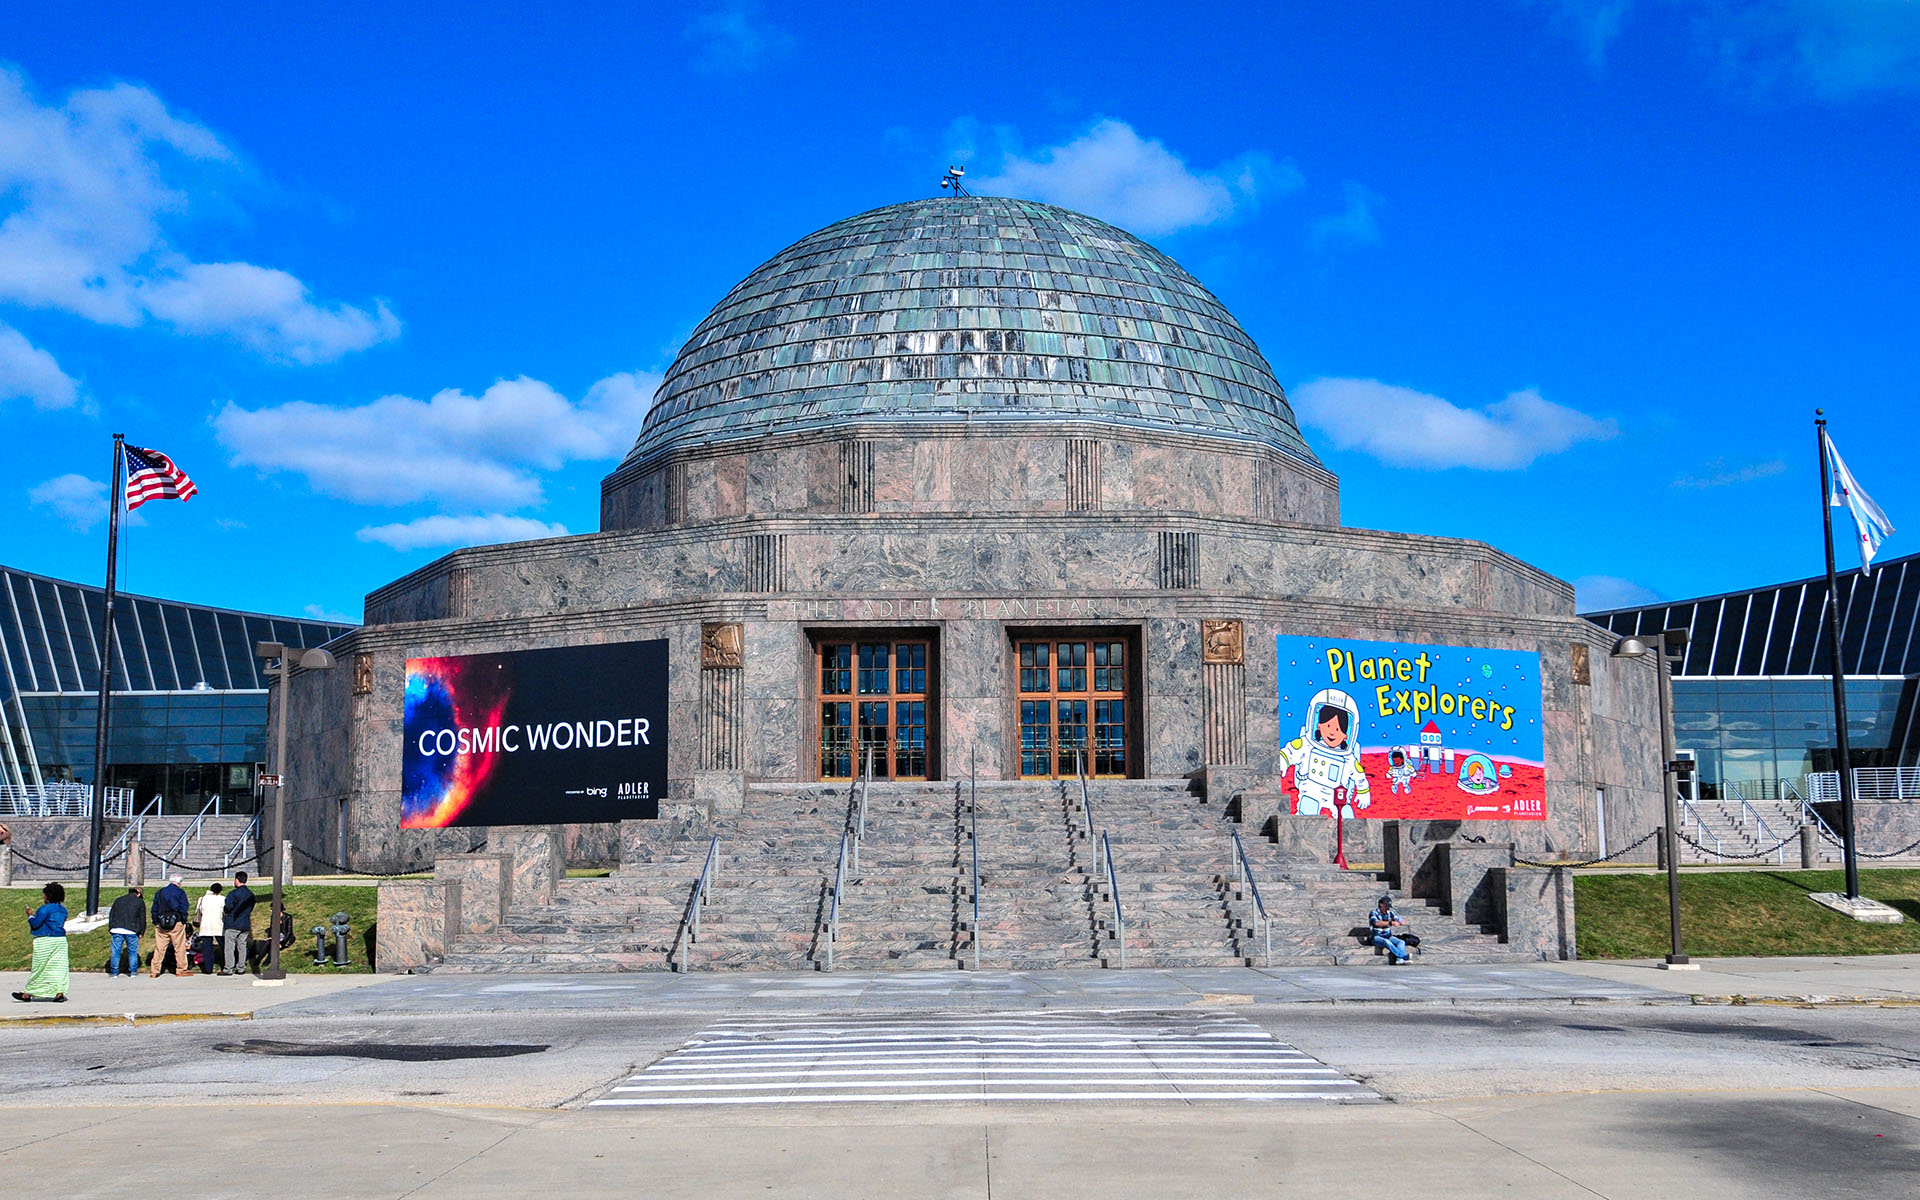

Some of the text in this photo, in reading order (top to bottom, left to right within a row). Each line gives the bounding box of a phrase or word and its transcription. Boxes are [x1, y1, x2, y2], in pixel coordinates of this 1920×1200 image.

[789, 598, 1153, 619] THE ADLER PLANETARIUM
[1326, 648, 1432, 683] Planet
[1376, 684, 1516, 731] Explorers
[418, 718, 650, 756] COSMIC WONDER
[586, 787, 608, 798] bing
[617, 782, 649, 795] ADLER
[1513, 800, 1541, 811] ADLER
